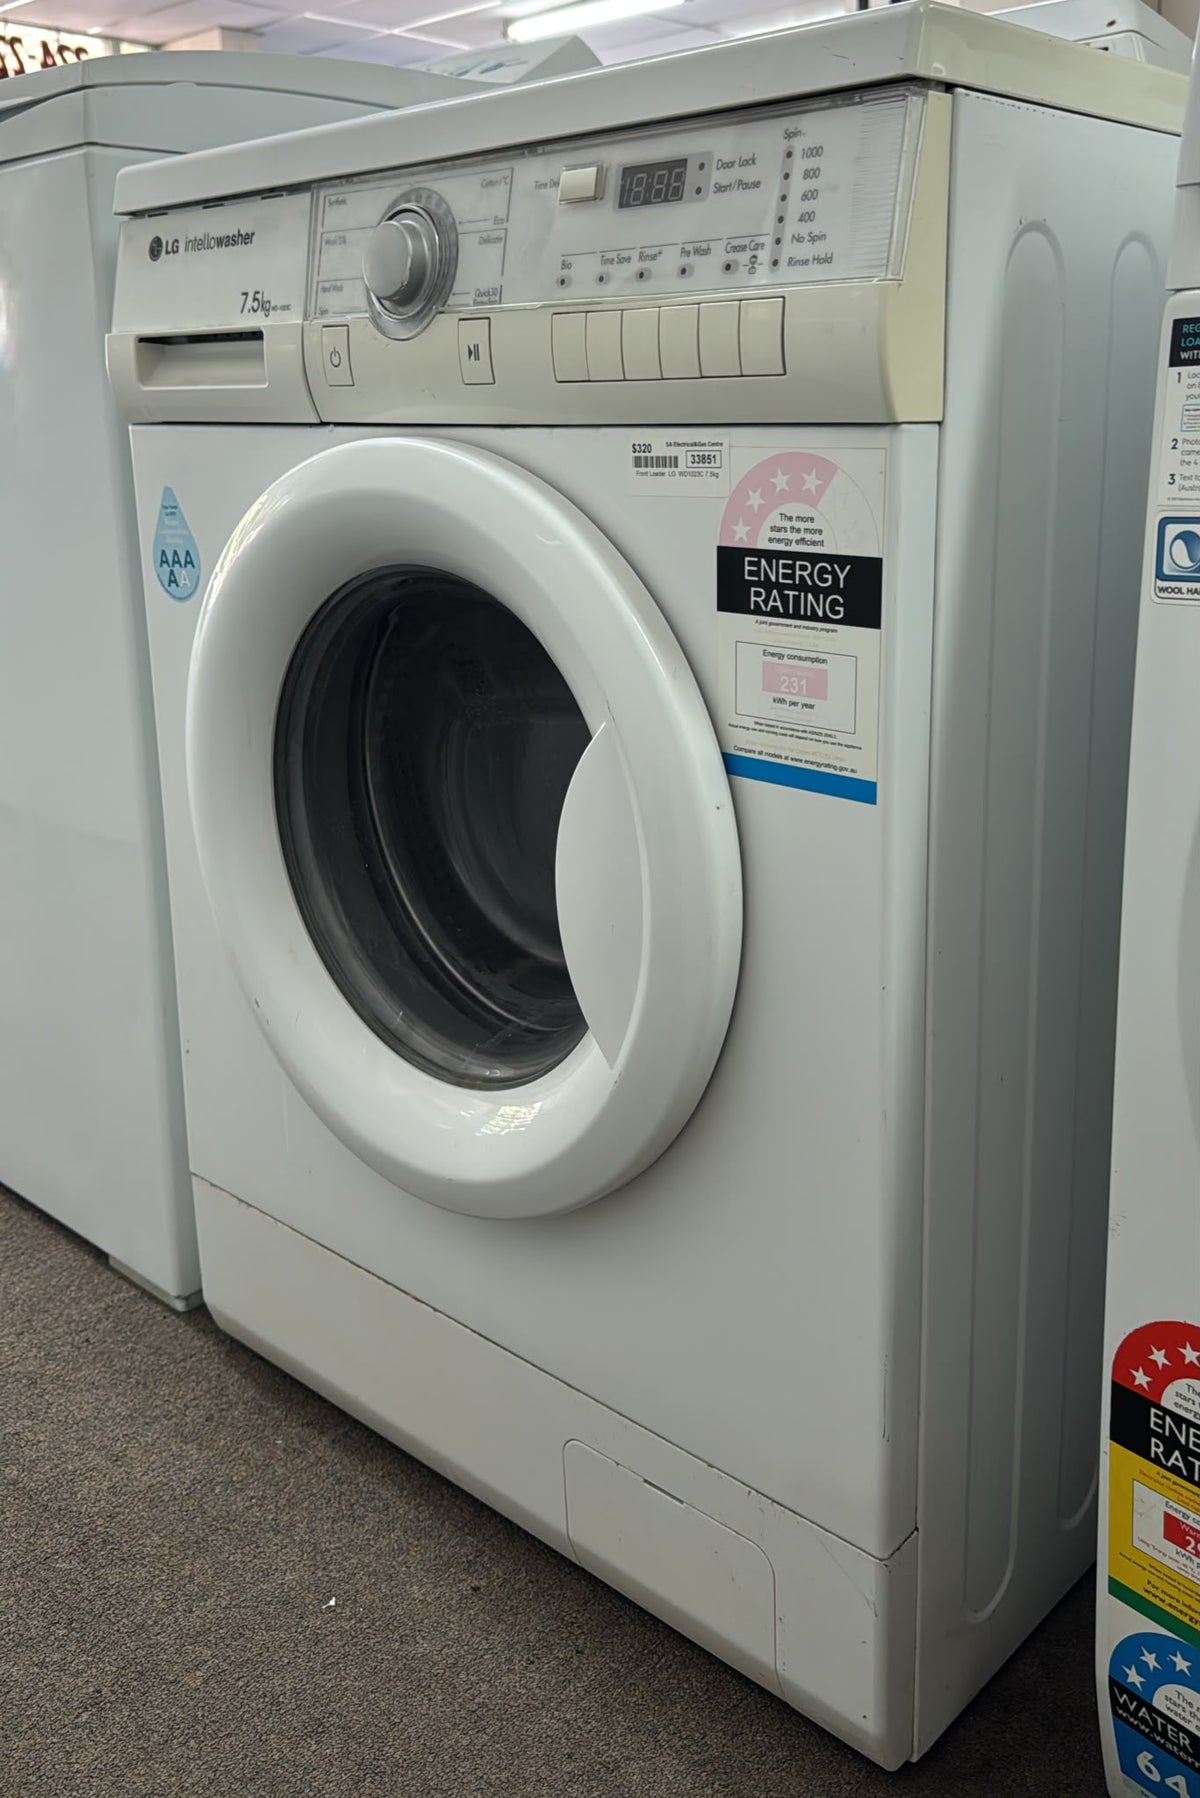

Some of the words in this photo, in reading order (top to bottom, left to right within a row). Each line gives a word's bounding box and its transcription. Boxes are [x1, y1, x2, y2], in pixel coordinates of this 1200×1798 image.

[783, 127, 802, 141] Spin
[801, 145, 824, 159] 1000
[716, 159, 736, 170] Door
[738, 152, 757, 167] Lock
[802, 167, 821, 180] 800
[534, 180, 549, 190] Time
[713, 179, 761, 194] Start/Pause
[801, 189, 819, 201] 600
[798, 211, 816, 223] 400
[165, 239, 180, 255] LG
[184, 228, 255, 253] intellowasher
[790, 233, 805, 244] No
[807, 231, 827, 245] Spin
[680, 246, 691, 257] Pre
[693, 243, 712, 256] Wash
[725, 242, 747, 254] Crease
[748, 239, 766, 251] Care
[561, 260, 573, 270] Bio
[600, 254, 615, 266] Time
[616, 253, 632, 264] Save
[787, 256, 810, 267] Rinse
[811, 251, 834, 265] Hold
[240, 290, 272, 318] 7.5kg
[1177, 371, 1182, 384] 1
[632, 443, 652, 454] $320
[1171, 438, 1179, 450] 2
[690, 454, 717, 465] 33851
[1167, 473, 1176, 485] 3
[779, 513, 793, 522] The
[795, 515, 815, 523] more
[769, 525, 788, 533] stars
[789, 526, 802, 534] the
[767, 537, 793, 547] energy
[795, 537, 825, 547] efficient
[160, 549, 195, 569] AAA
[744, 556, 851, 588] ENERGY
[1157, 586, 1184, 595] WOOL
[750, 587, 845, 620] RATING
[762, 649, 785, 660] Energy
[786, 653, 828, 665] consumption
[780, 675, 808, 696] 231
[772, 696, 788, 705] kWh
[788, 699, 800, 708] per
[800, 701, 816, 710] year
[733, 744, 757, 755] Compare
[764, 751, 783, 760] models
[1175, 1391, 1195, 1406] stars
[1165, 1500, 1190, 1521] Energy
[1164, 1694, 1187, 1713] stars
[1174, 1689, 1195, 1710] The
[1113, 1686, 1194, 1754] WATER
[1165, 1703, 1193, 1726] water
